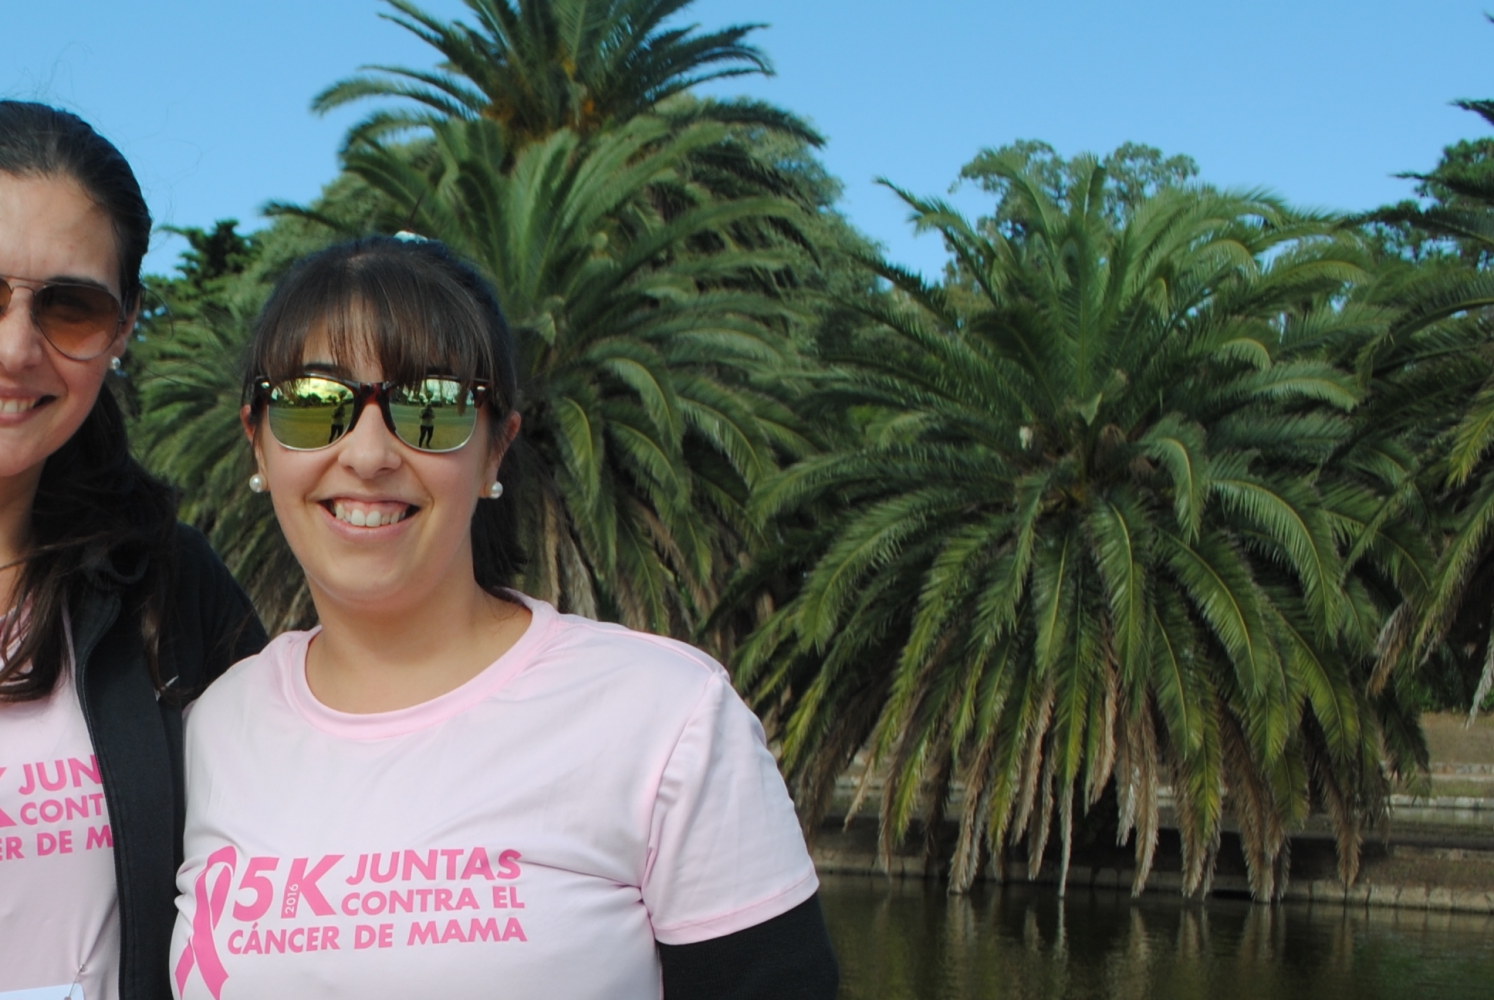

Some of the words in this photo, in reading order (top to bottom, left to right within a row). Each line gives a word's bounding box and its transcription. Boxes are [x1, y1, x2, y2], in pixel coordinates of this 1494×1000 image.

[18, 754, 104, 795] JUN
[20, 792, 105, 826] CONT
[36, 829, 73, 857] DE
[346, 847, 522, 885] JUNTAS
[232, 854, 345, 922] 5K
[283, 882, 299, 916] 2016
[341, 887, 480, 917] CONTRA
[492, 886, 526, 909] EL
[227, 922, 341, 955] CÁNCER
[354, 924, 394, 949] DE
[406, 917, 528, 946] MAMA
